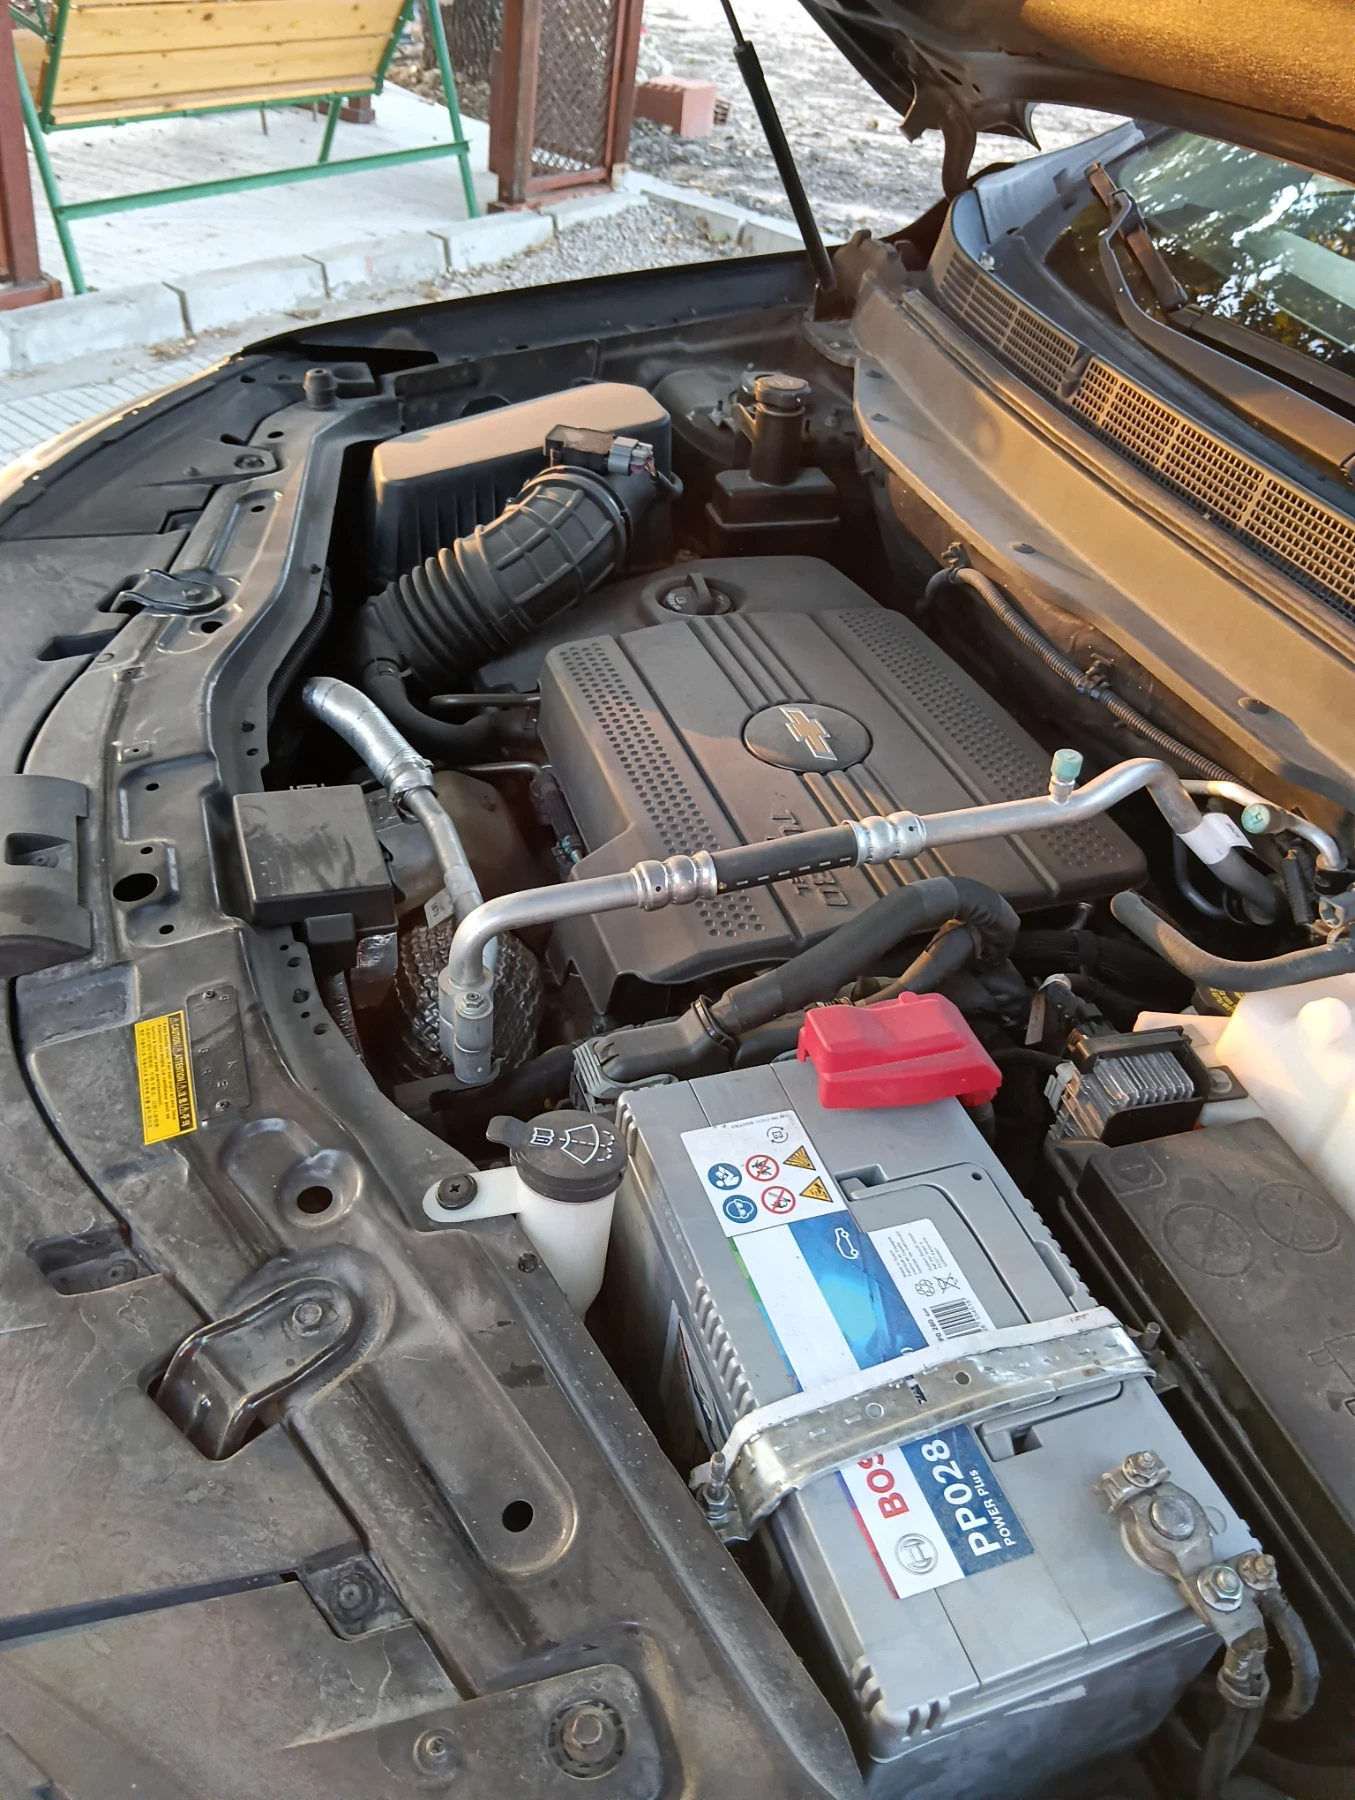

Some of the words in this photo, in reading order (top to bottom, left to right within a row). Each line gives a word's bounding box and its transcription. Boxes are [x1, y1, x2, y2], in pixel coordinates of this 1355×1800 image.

[171, 1023, 180, 1046] CAUTION
[174, 1053, 185, 1083] ATTENTION
[921, 1438, 1002, 1557] PP028
[969, 1469, 989, 1497] Plus
[983, 1498, 1016, 1547] POWER
